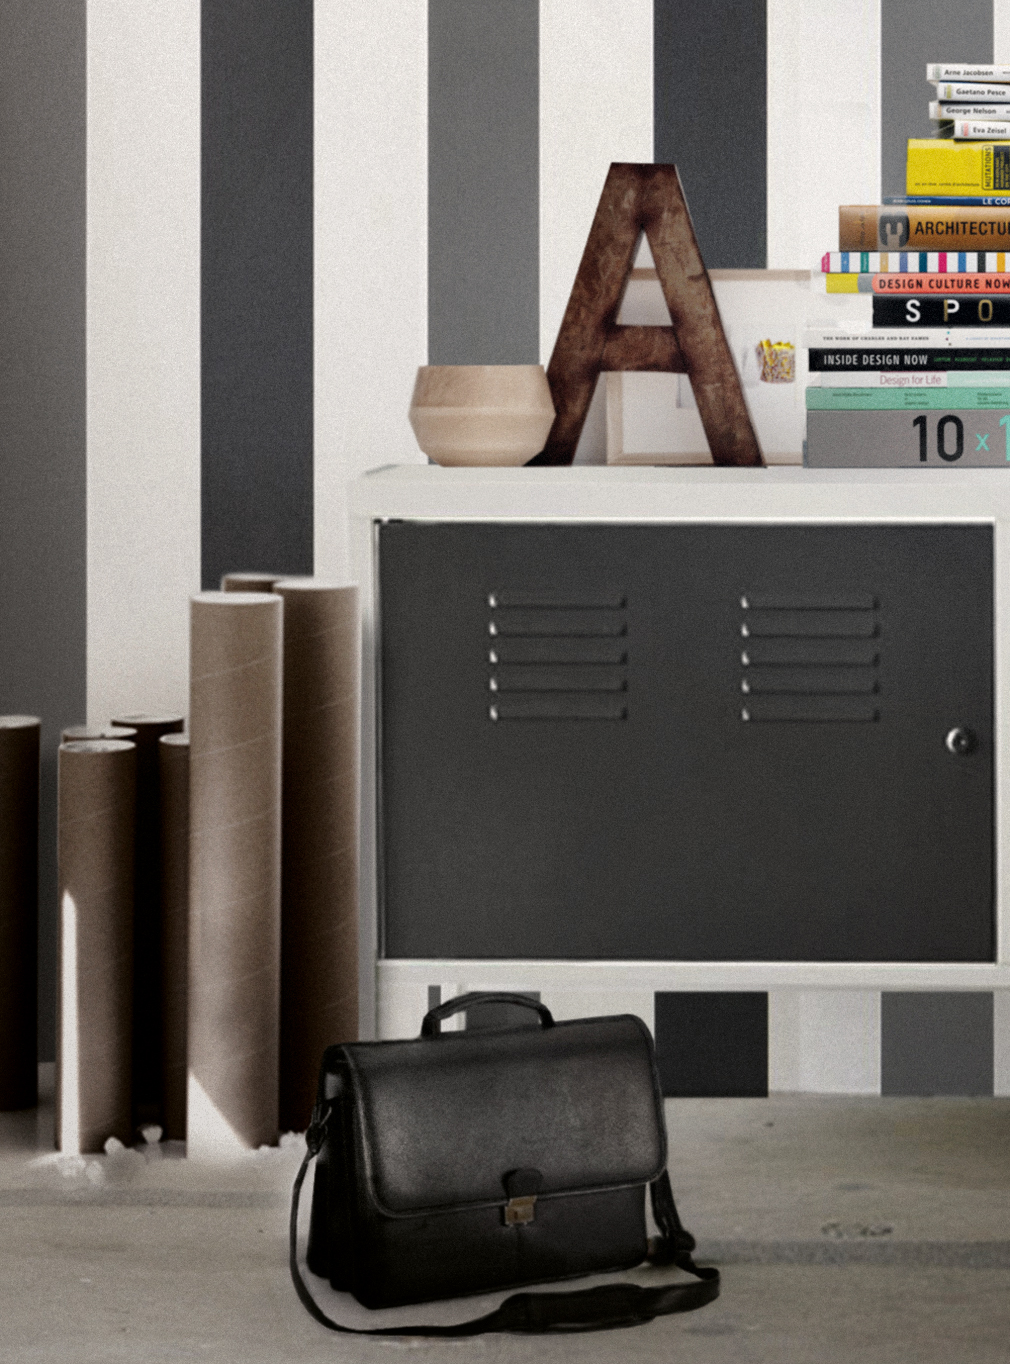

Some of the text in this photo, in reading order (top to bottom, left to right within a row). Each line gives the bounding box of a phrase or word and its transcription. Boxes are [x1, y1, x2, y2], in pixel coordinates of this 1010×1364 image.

[962, 68, 994, 76] Jacobsen
[956, 88, 985, 96] Gaetano
[946, 107, 973, 116] George
[975, 107, 997, 115] Nelson
[879, 279, 923, 289] DESIGN
[928, 279, 980, 289] CULTURE
[985, 279, 1010, 289] NOW
[823, 354, 859, 366] INSIDE
[862, 354, 900, 366] DESIGN
[904, 354, 928, 366] NOW
[879, 374, 942, 387] Design for Life
[912, 414, 964, 462] 10
